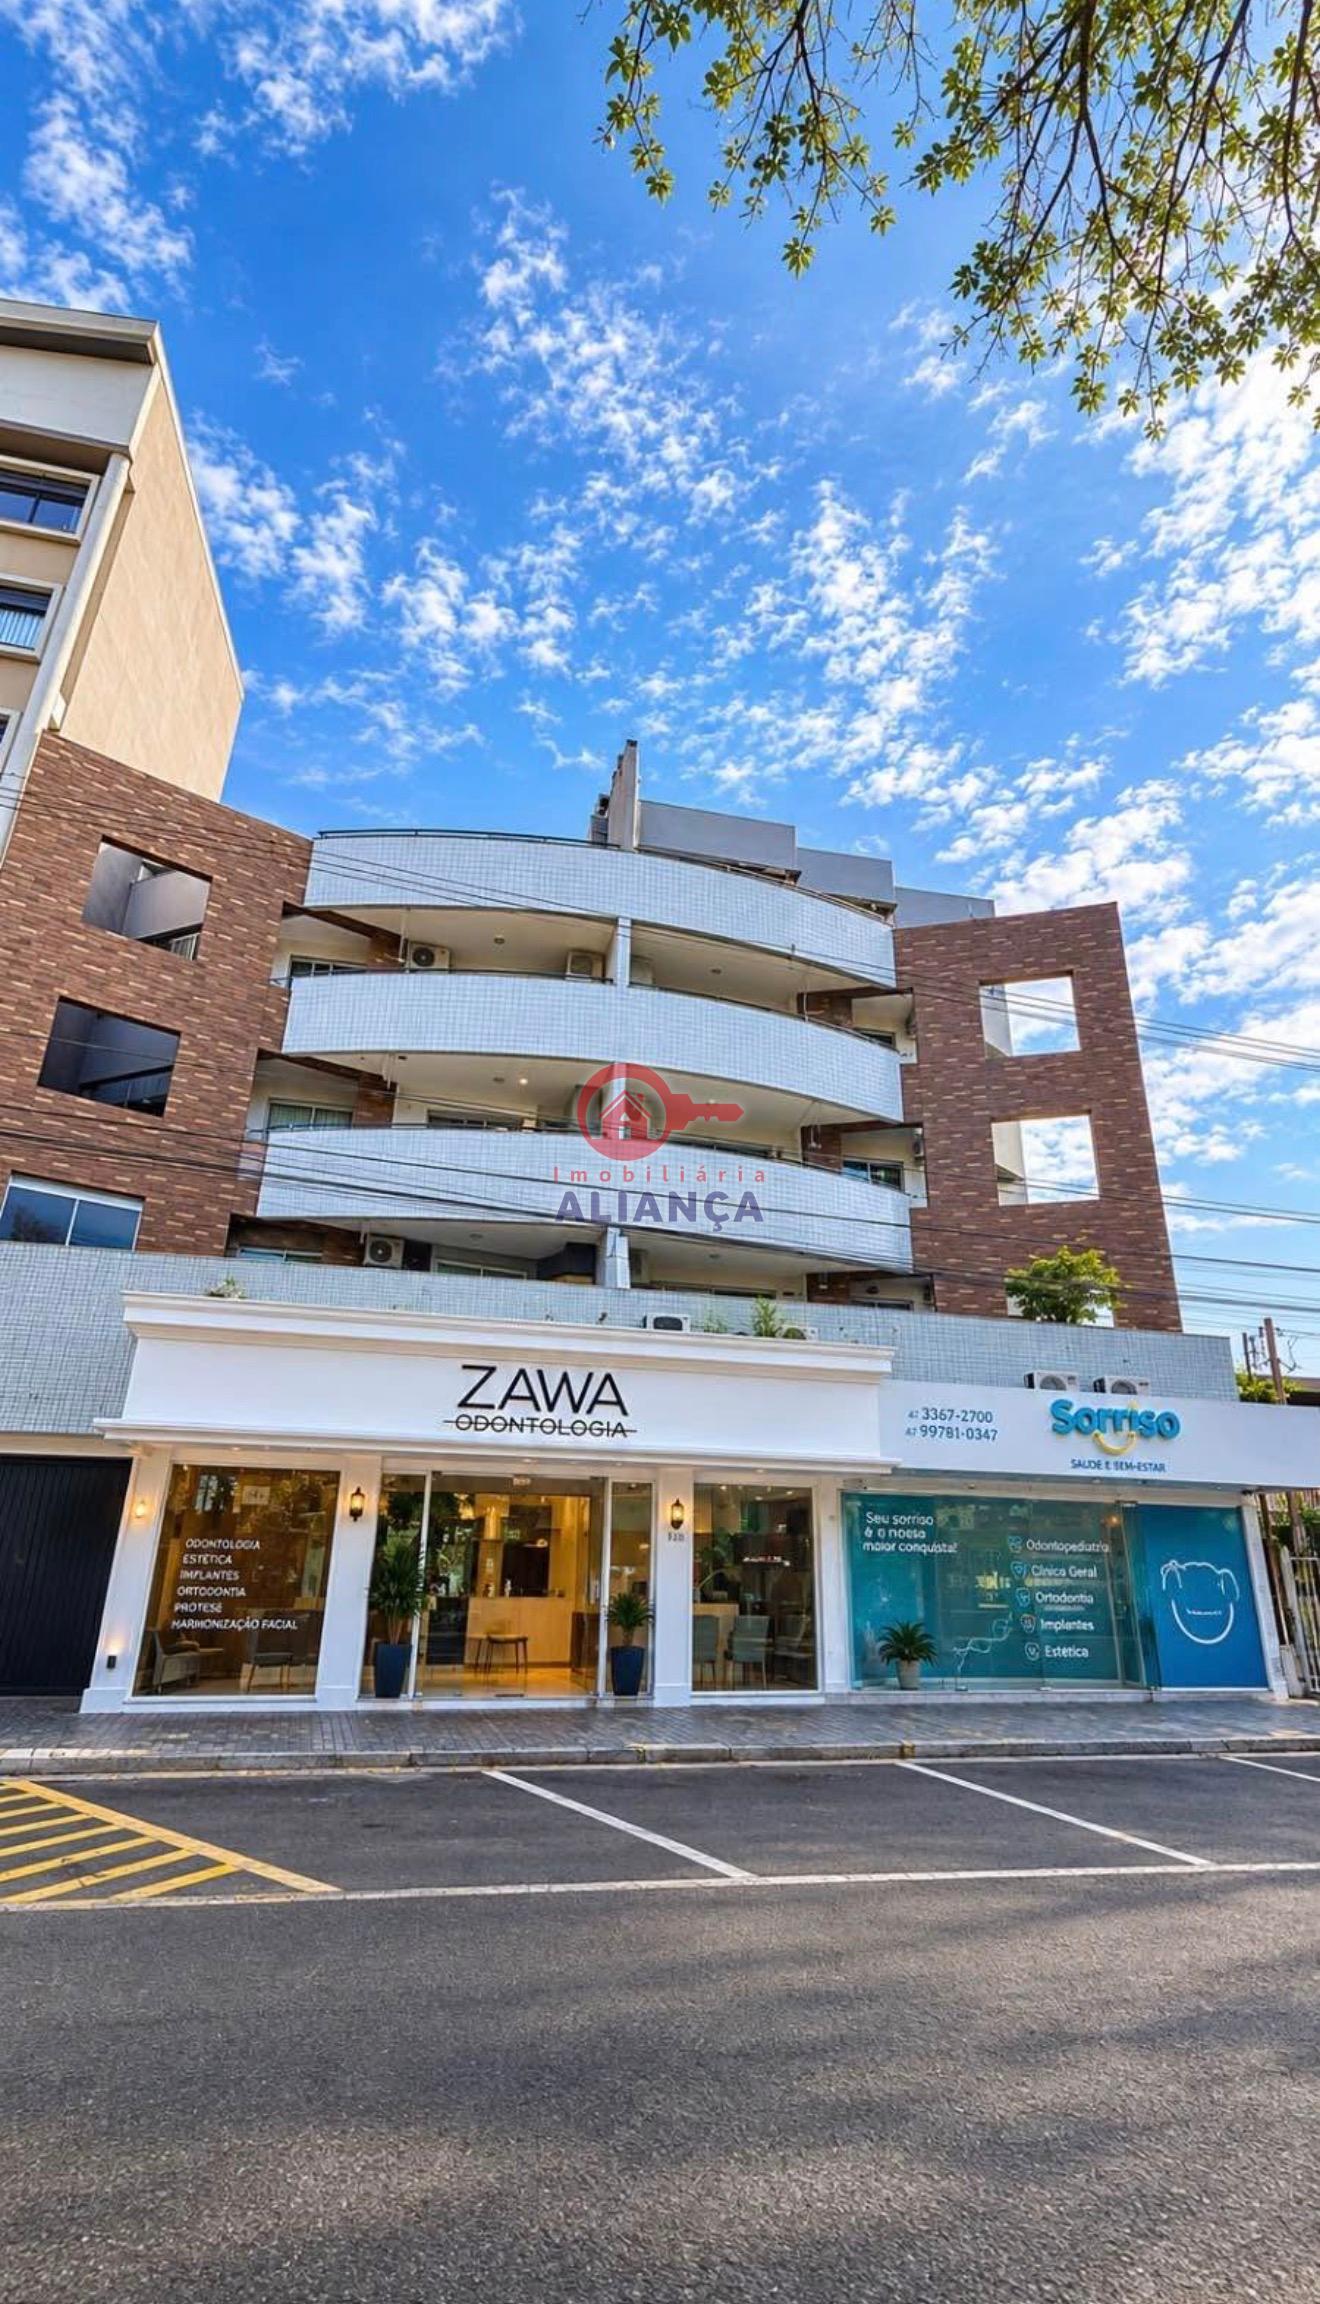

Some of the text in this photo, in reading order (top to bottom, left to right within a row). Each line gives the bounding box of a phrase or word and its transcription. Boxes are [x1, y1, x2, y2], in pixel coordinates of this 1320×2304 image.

[457, 1364, 629, 1417] ZAWA
[921, 1406, 994, 1424] 3367-2700
[1050, 1399, 1181, 1440] Sorriso
[455, 1413, 629, 1438] ODONTOLOGIA
[919, 1425, 998, 1441] 99781-0347
[865, 1511, 890, 1525] Seu
[185, 1538, 261, 1550] ODONTOLOGIA
[180, 1569, 240, 1581] IMPLANTES
[1068, 1565, 1098, 1578] Geral
[176, 1585, 247, 1597] ORTODONTIA
[260, 1618, 298, 1631] FACIAL
